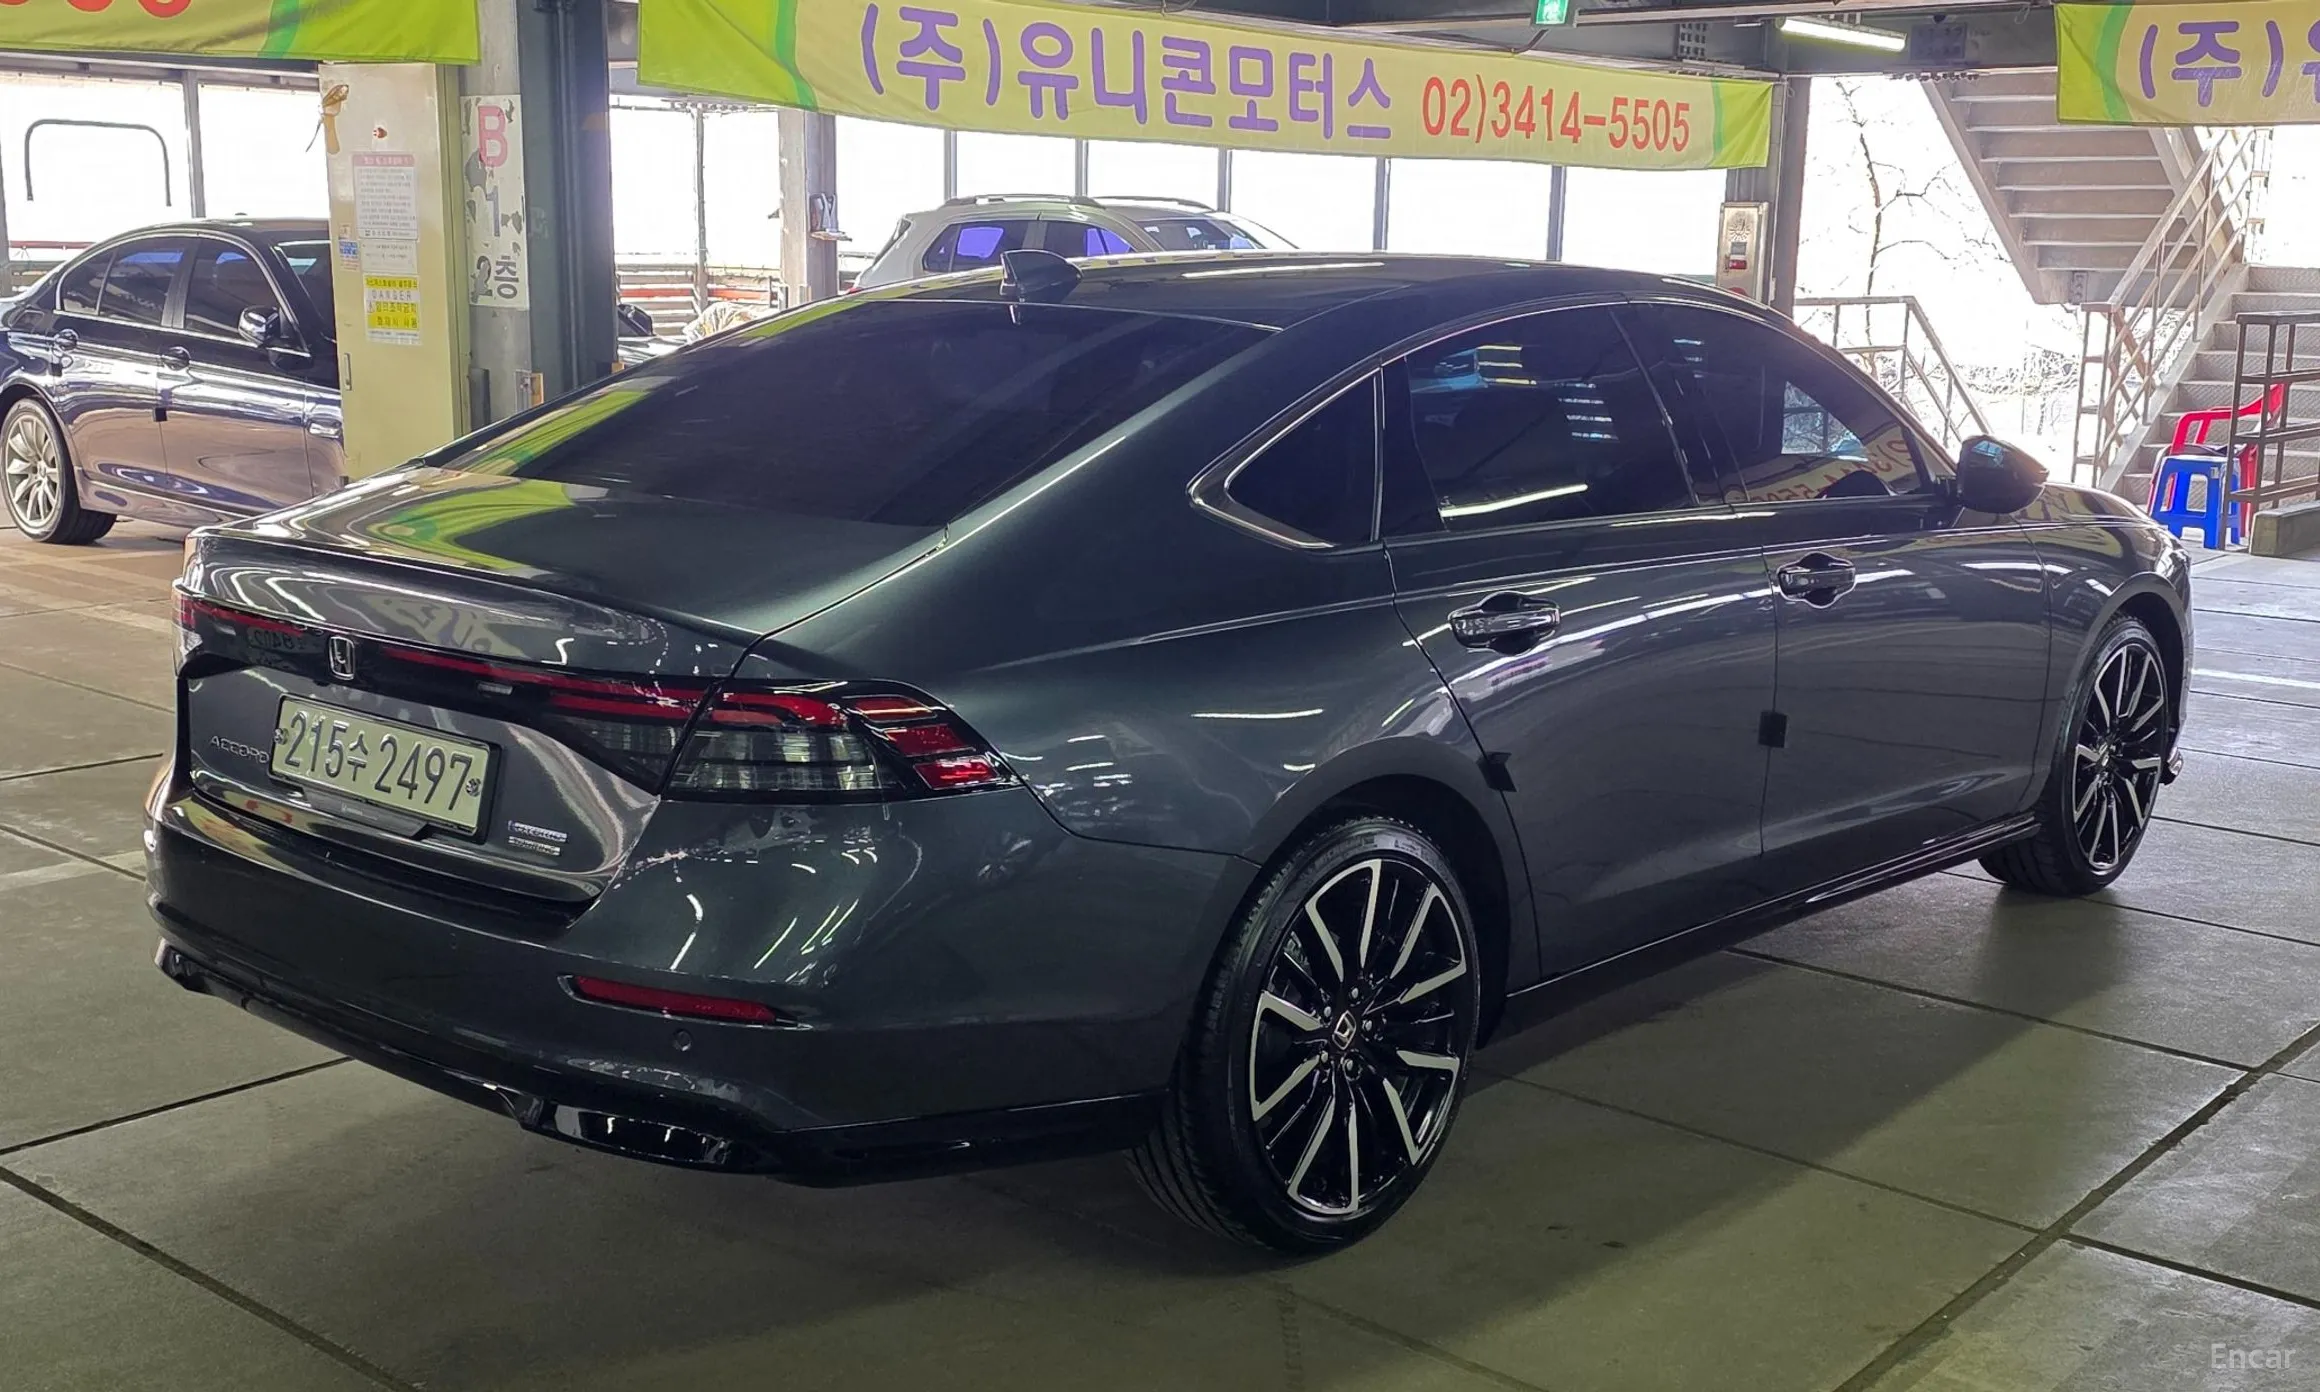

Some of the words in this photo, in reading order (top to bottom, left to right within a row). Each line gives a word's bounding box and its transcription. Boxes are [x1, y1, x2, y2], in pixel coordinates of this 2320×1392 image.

[860, 2, 1392, 139] (주)유니콘모터스
[1422, 73, 1690, 151] 02)3414-5505
[2139, 19, 2320, 108] (주)
[209, 735, 270, 764] ACCORD
